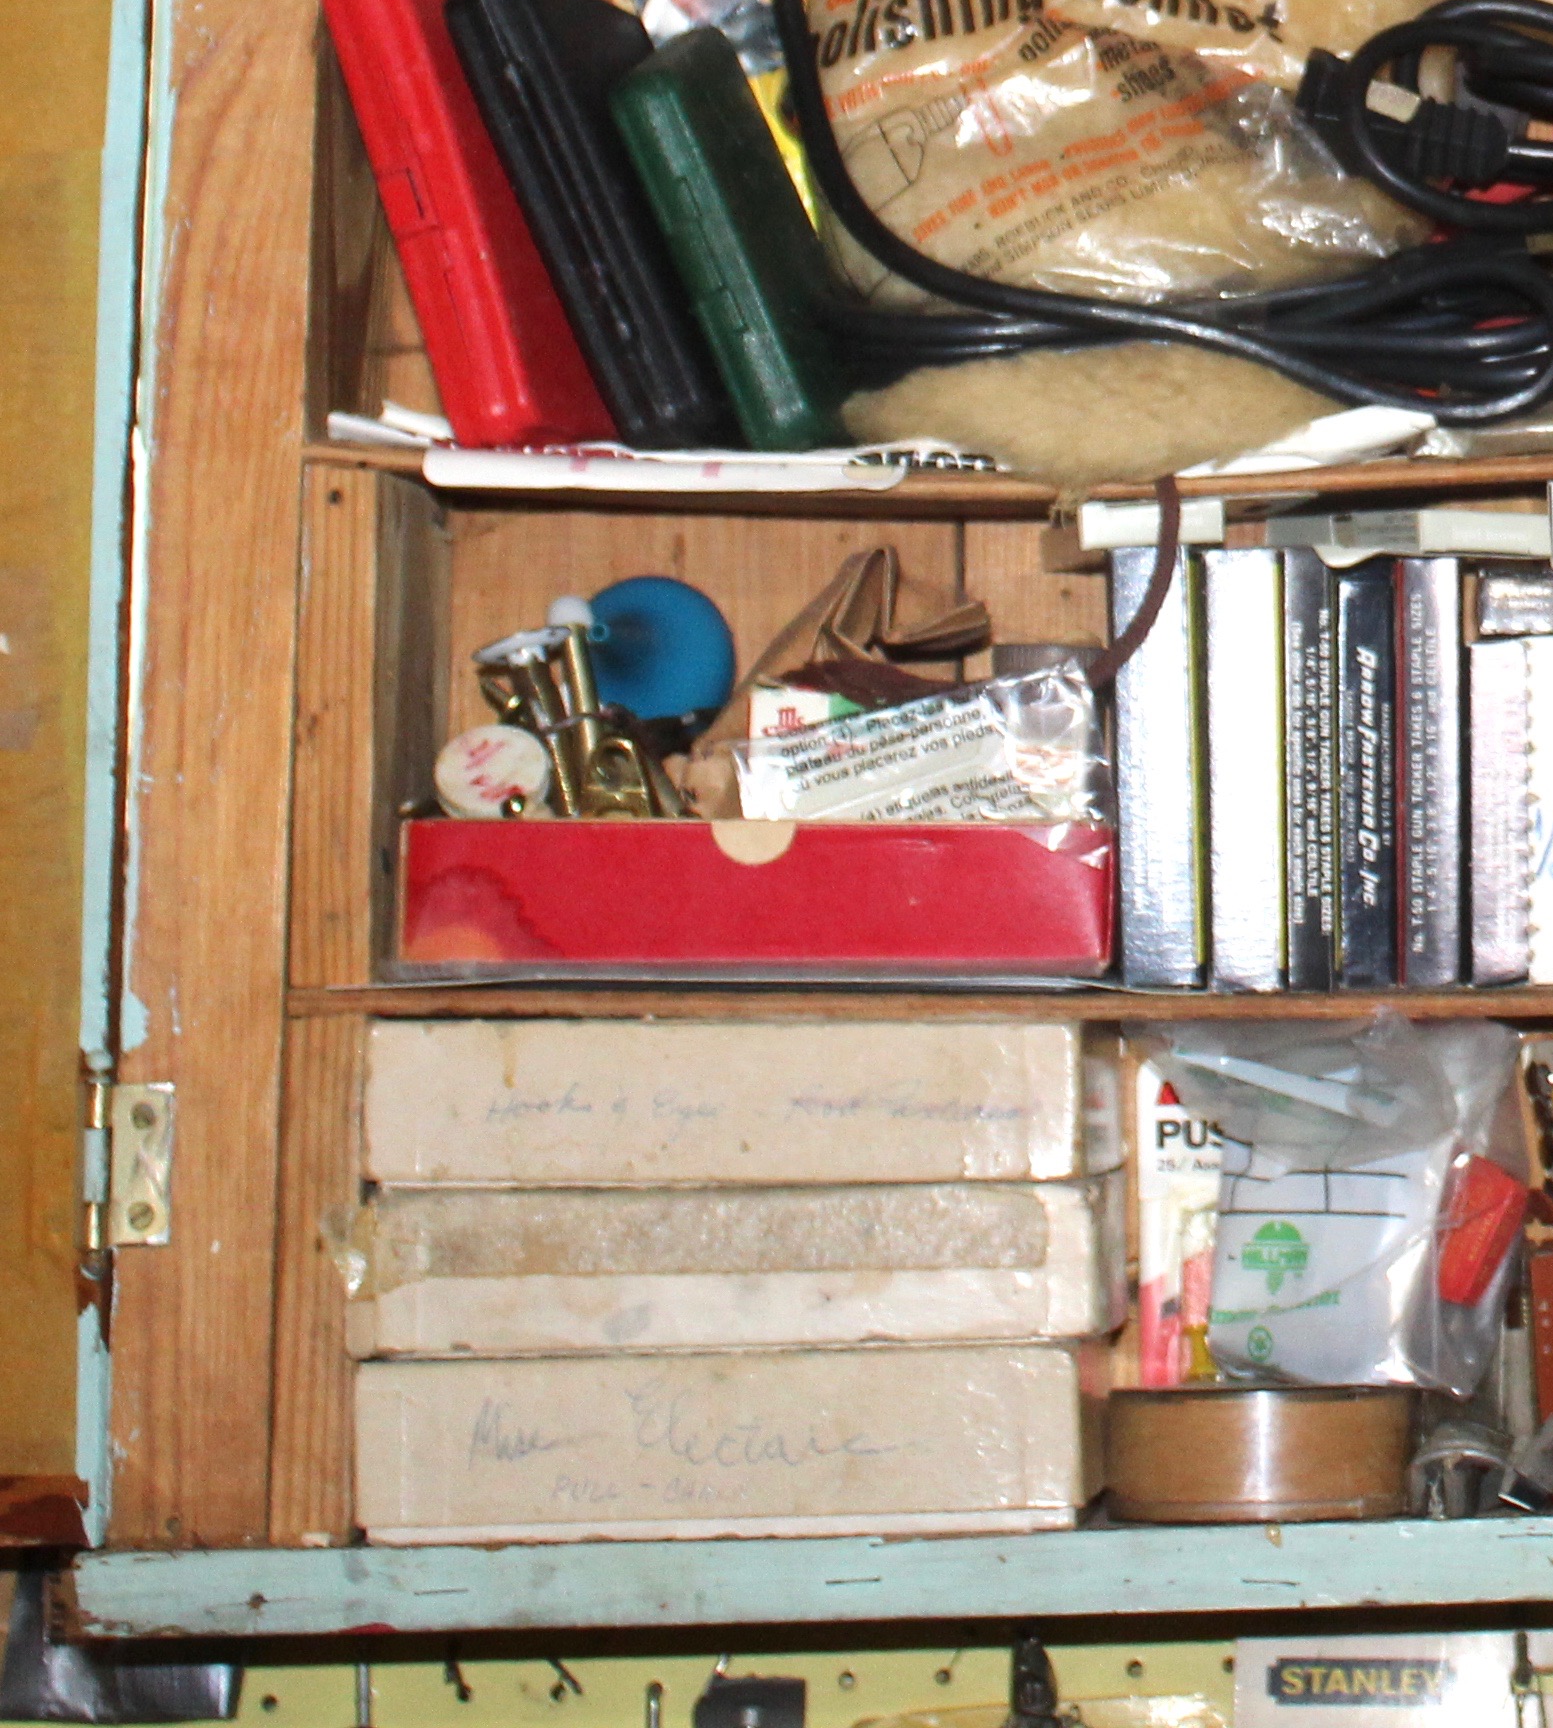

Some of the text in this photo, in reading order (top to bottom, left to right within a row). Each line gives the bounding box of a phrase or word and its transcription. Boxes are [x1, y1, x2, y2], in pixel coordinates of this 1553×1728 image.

[1319, 663, 1332, 707] STAPLE
[1355, 646, 1379, 724] ARROW
[1319, 710, 1332, 735] GUN
[1411, 705, 1423, 745] TAKES
[812, 764, 852, 789] vous
[1319, 740, 1332, 782] TACKER
[1355, 725, 1379, 828] FASTENER
[1411, 752, 1423, 802] TACKER
[1319, 787, 1332, 833] TAKES
[1411, 810, 1423, 838] GUN
[1319, 848, 1332, 893] STAPLE
[1411, 843, 1423, 892] STAPLE
[1280, 1665, 1443, 1697] STANLEY
